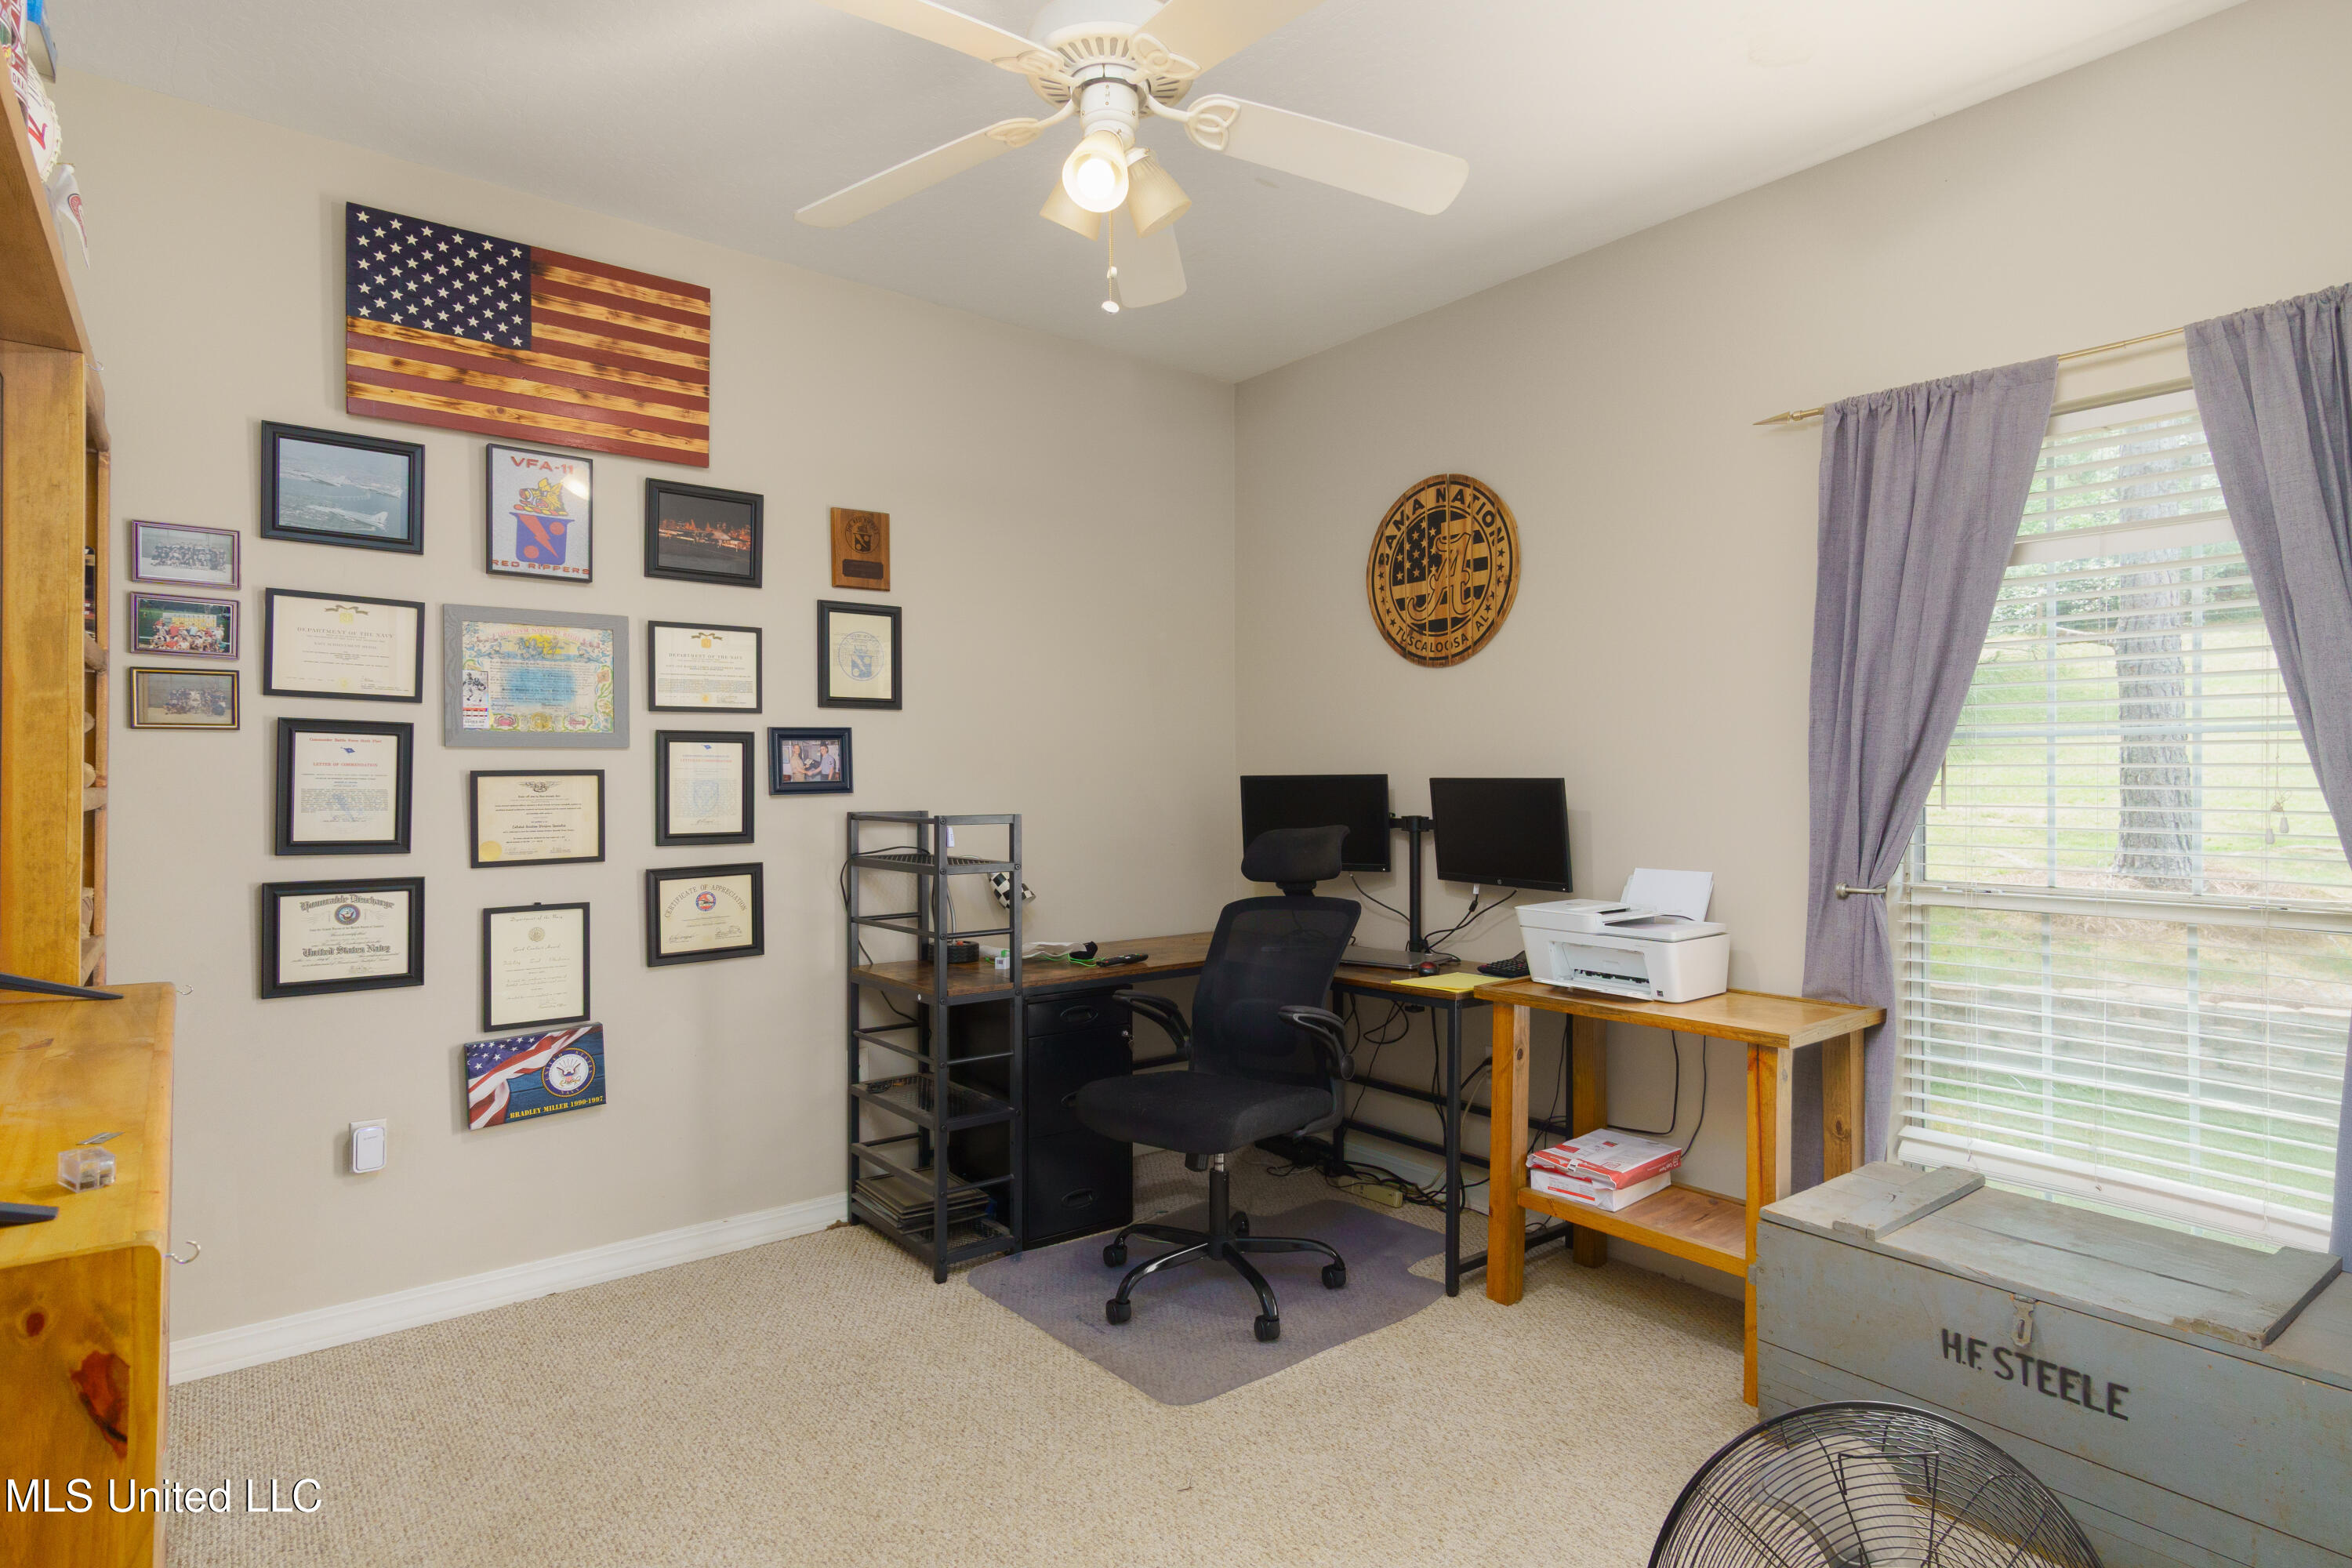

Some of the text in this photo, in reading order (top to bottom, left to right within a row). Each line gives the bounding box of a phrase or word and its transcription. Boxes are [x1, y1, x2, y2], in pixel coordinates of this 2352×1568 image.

[510, 456, 574, 474] VFA-11
[1378, 487, 1504, 565] BAMA NATION
[528, 563, 590, 575] RIPPERS
[1475, 615, 1490, 631] AL
[665, 886, 698, 918] CERTIFICATE
[711, 884, 747, 911] APPRECIATION
[302, 944, 390, 957] United States Navy
[510, 1095, 604, 1119] BRADLEY MILLER 1990-1997
[1994, 1347, 2129, 1421] STEELE
